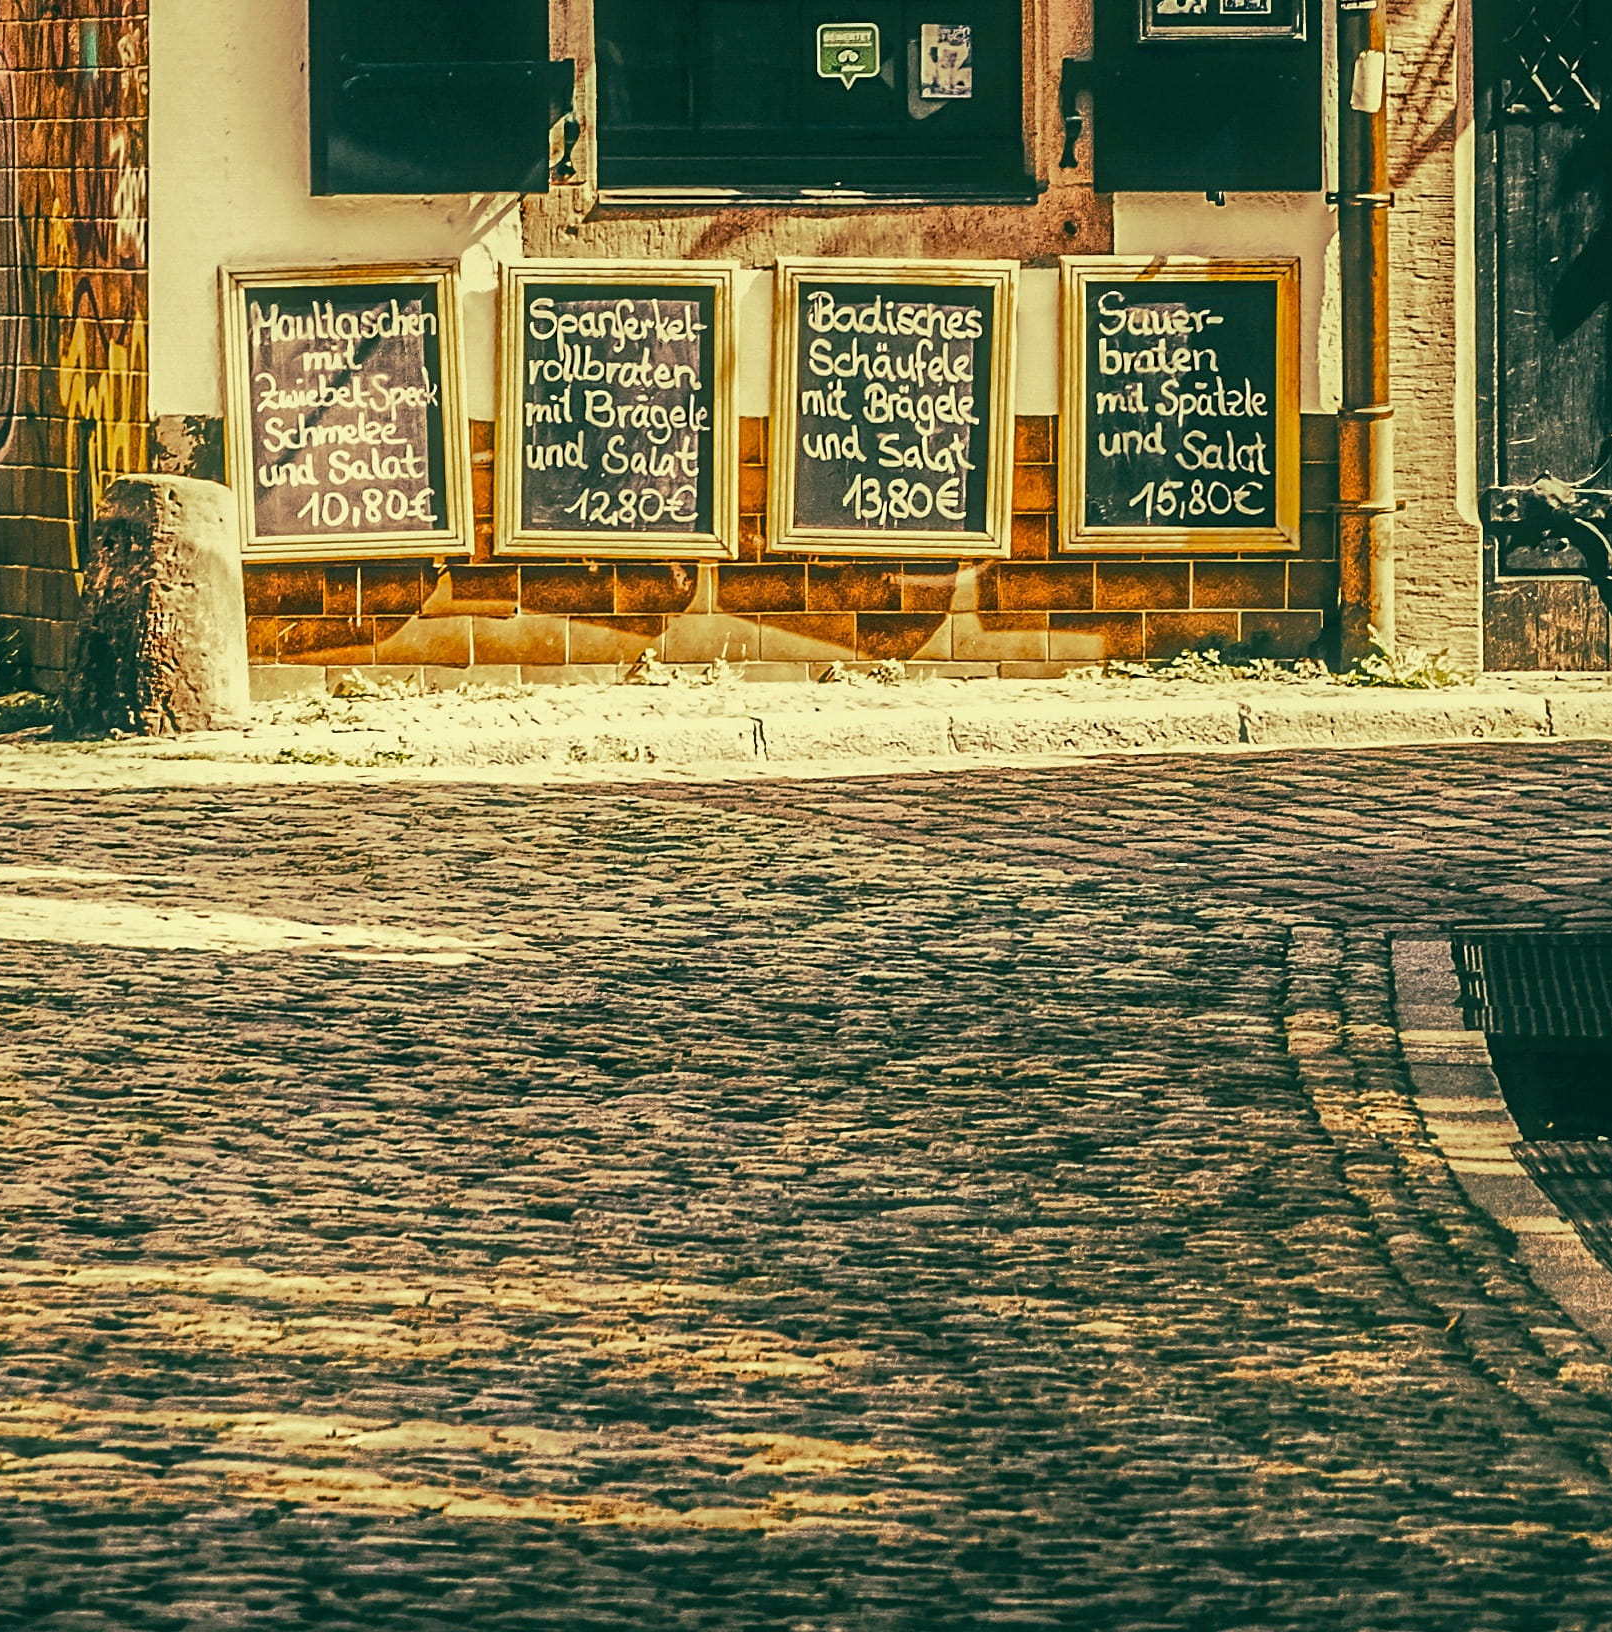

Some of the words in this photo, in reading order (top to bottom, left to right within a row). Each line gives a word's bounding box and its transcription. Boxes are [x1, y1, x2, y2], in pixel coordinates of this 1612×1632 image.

[251, 299, 436, 347] Maultaschen
[530, 297, 707, 361] Spanferkel-
[807, 291, 983, 340] Badisches
[1097, 291, 1224, 335] Sauer-
[303, 340, 362, 371] mit
[528, 345, 702, 390] rollbraten
[809, 337, 973, 388] Schäufele
[1098, 338, 1219, 375] braten
[525, 388, 574, 426] mit
[584, 390, 710, 445] Brägele
[801, 379, 852, 421] mit
[863, 383, 980, 437] Brägele
[1096, 382, 1149, 415] mit
[1154, 376, 1268, 427] Spätzle
[263, 412, 407, 452] Schmelze
[526, 430, 588, 471] und
[602, 435, 699, 479] Salat
[802, 425, 867, 461] und
[878, 433, 975, 473] Salat
[1098, 422, 1167, 457] und
[1175, 430, 1270, 475] Salat
[259, 454, 319, 487] und
[328, 445, 425, 485] Salat
[297, 487, 438, 527] 10,80€
[842, 474, 966, 525] 13,80€
[1129, 479, 1265, 519] 15,80€
